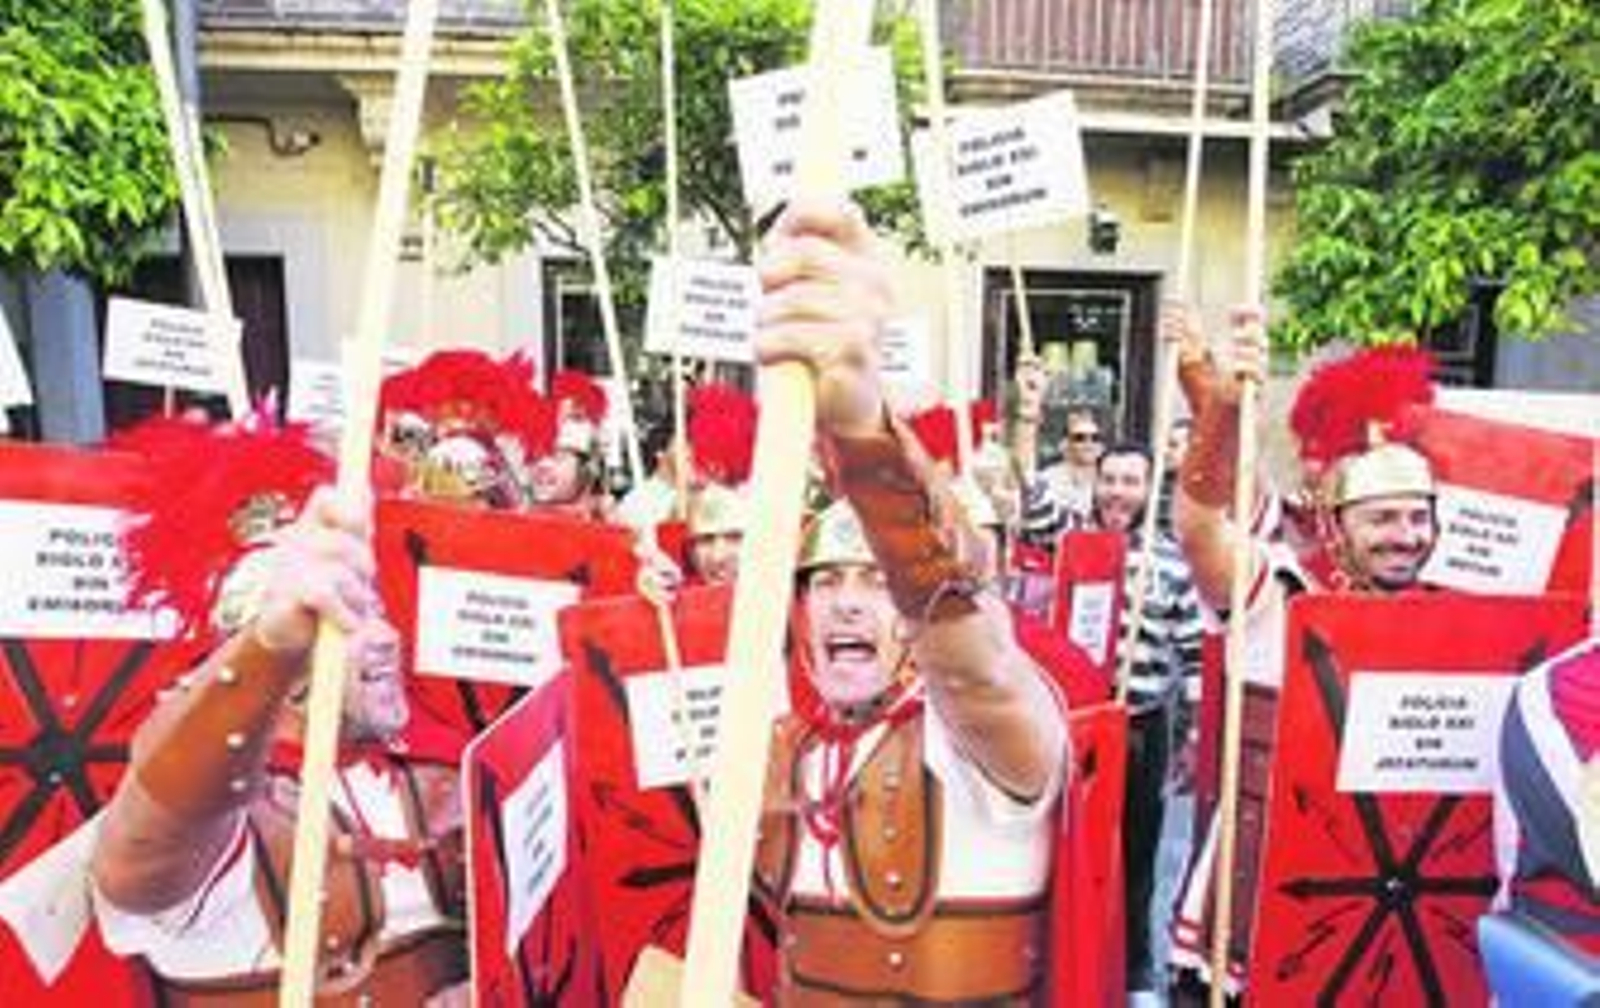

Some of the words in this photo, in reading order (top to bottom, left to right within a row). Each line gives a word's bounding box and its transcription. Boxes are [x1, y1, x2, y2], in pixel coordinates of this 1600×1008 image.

[36, 551, 104, 570] SIGLO
[73, 576, 109, 592] SIN
[1399, 694, 1468, 711] POLICIA
[1388, 716, 1440, 730] SIGLO
[1445, 716, 1474, 730] XXI
[1415, 737, 1443, 751] SIN
